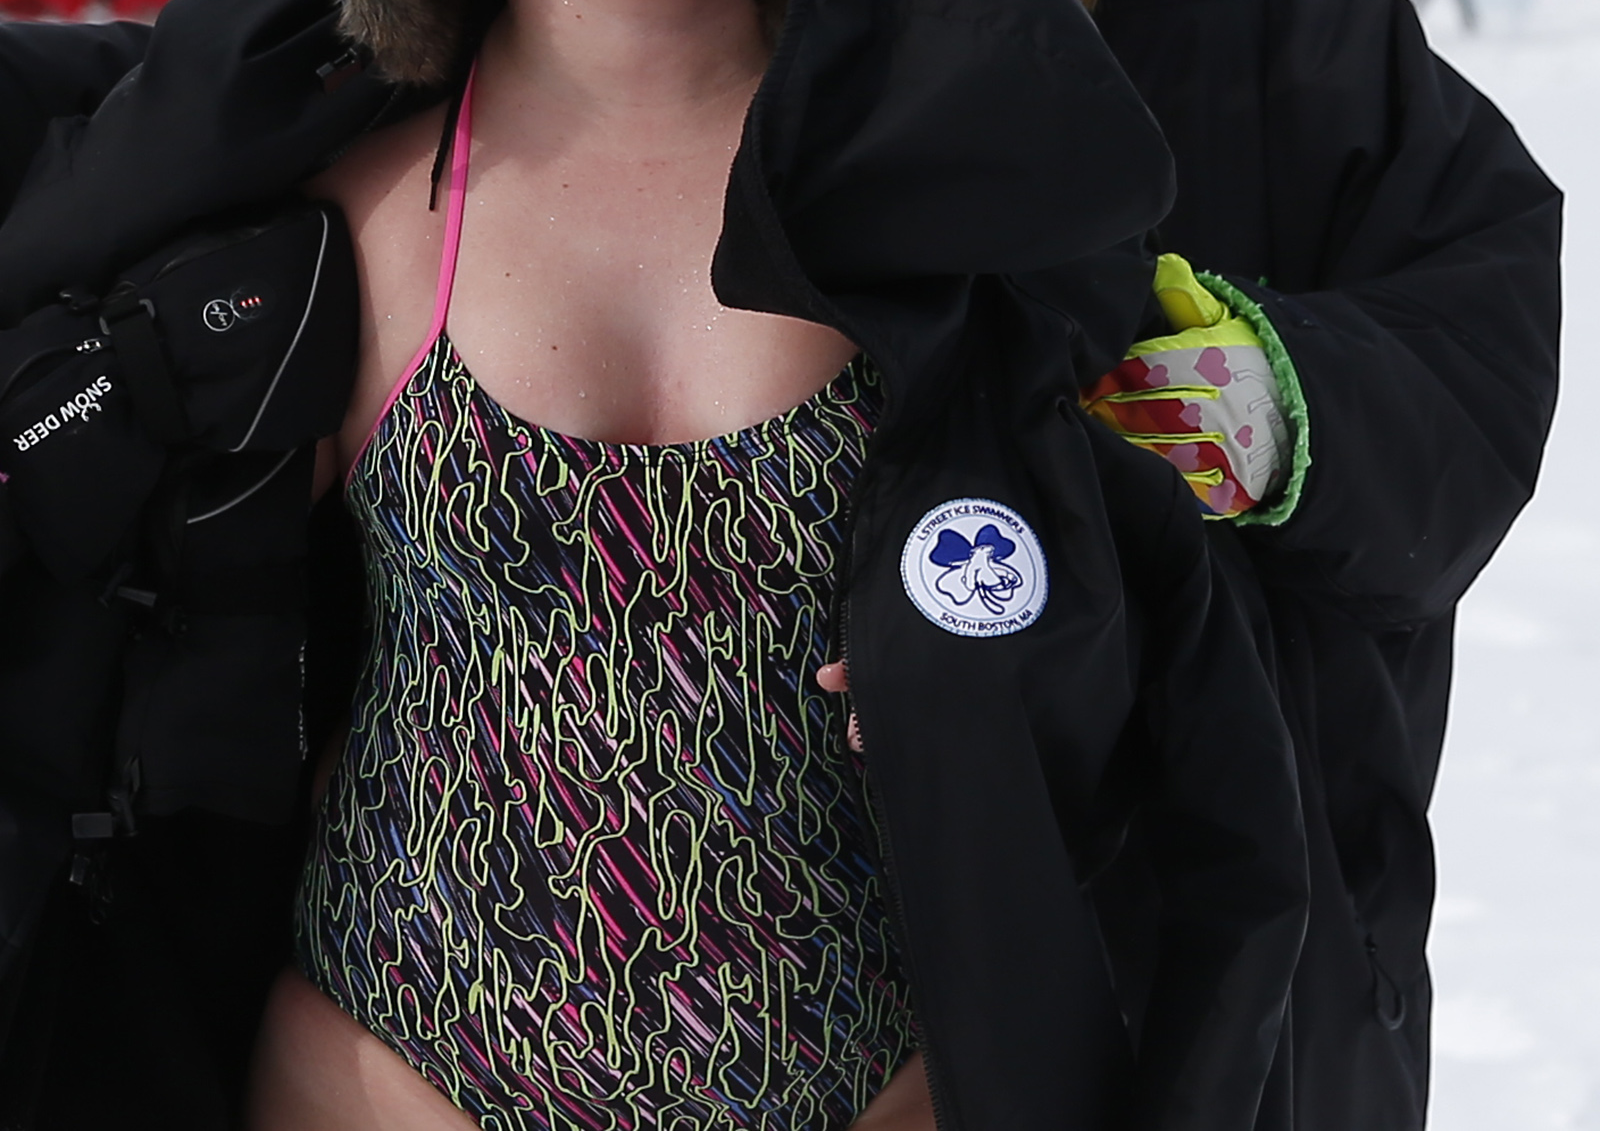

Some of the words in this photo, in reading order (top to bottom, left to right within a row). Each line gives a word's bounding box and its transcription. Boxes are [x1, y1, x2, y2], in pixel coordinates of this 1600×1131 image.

[60, 375, 112, 422] SNOW
[13, 414, 61, 451] DEER
[920, 510, 953, 537] STREET
[953, 505, 970, 516] ICE
[972, 505, 1025, 534] SWIMMERS
[940, 612, 976, 631] SOUTH
[1018, 609, 1033, 622] MA
